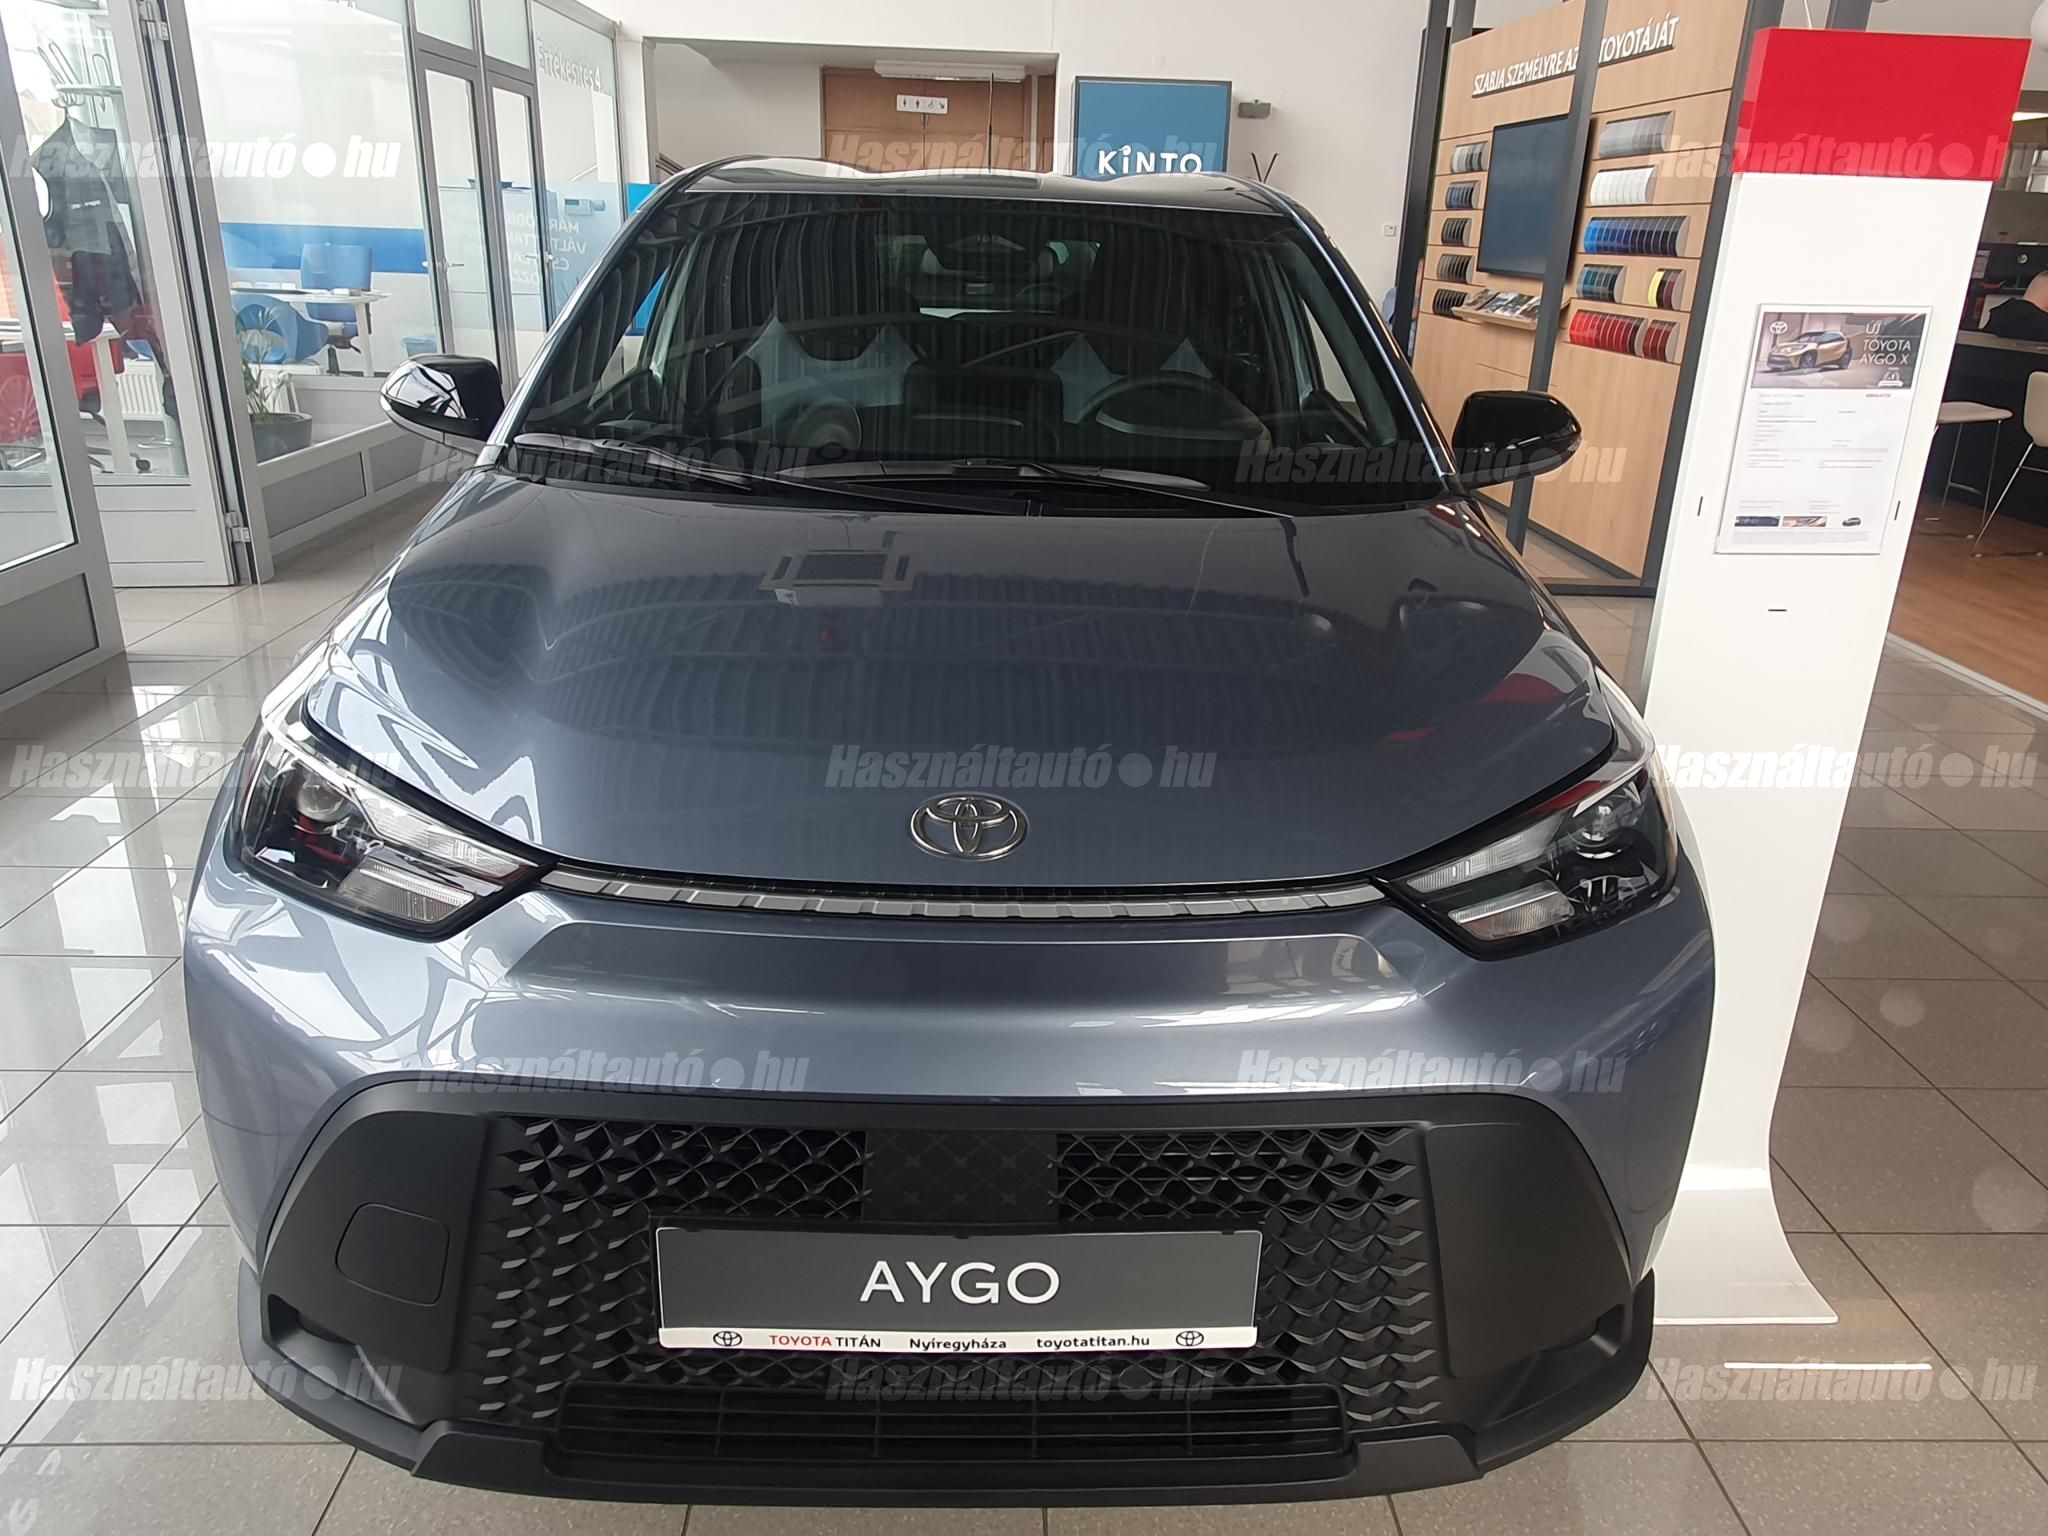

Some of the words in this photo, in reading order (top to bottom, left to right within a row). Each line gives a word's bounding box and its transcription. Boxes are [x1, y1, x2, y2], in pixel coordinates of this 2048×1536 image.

[1472, 67, 1506, 96] SZABJA
[1506, 51, 1564, 88] SZEMÉLYRE
[1598, 12, 1680, 64] TOYOTÁJÁT
[1865, 319, 1882, 335] ÚJ
[1863, 339, 1911, 352] TOYOTA
[1859, 353, 1897, 365] AYGO
[1899, 355, 1910, 365] X
[859, 1260, 1060, 1304] AYGO
[769, 1334, 832, 1346] TOYOTA
[835, 1333, 881, 1348] TITÁN
[909, 1337, 1007, 1351] Nyíregyháza
[1036, 1334, 1151, 1350] toyotatitan.hu
